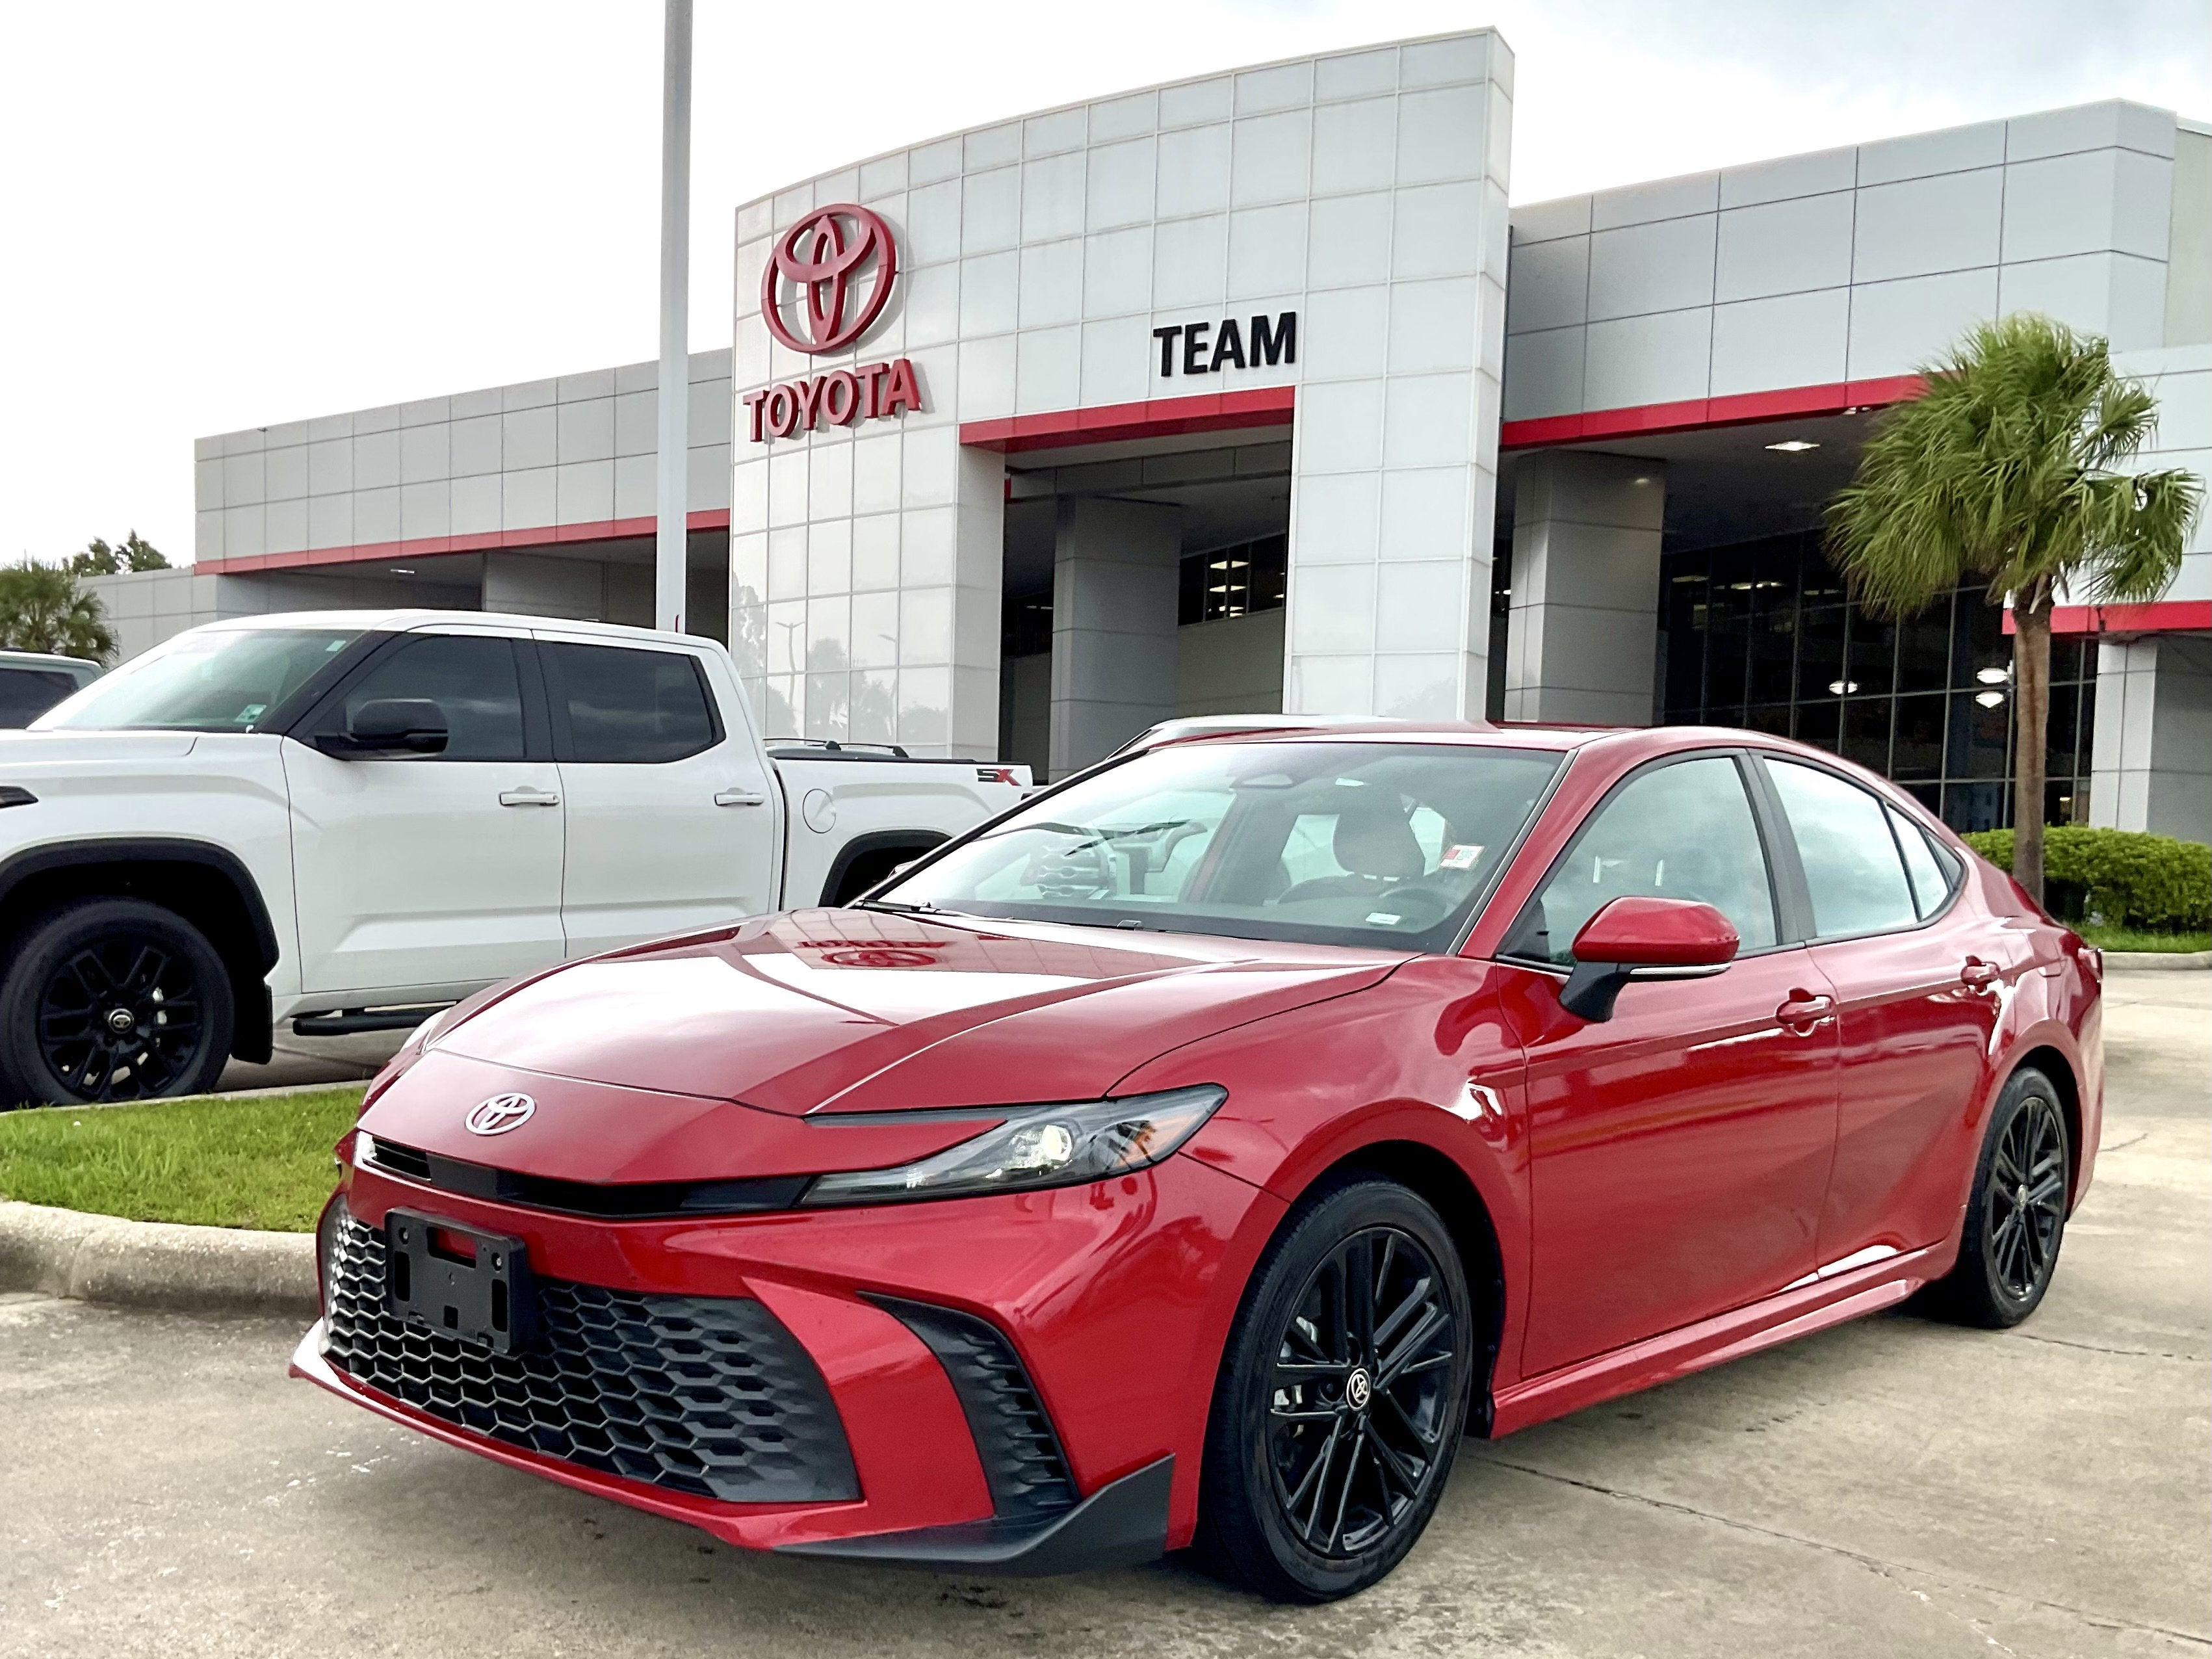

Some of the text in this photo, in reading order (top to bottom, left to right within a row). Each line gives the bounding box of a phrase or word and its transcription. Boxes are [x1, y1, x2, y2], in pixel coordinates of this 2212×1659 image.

[1153, 311, 1296, 376] TEAM
[743, 358, 921, 442] TOYOTA
[976, 768, 1022, 787] SX
